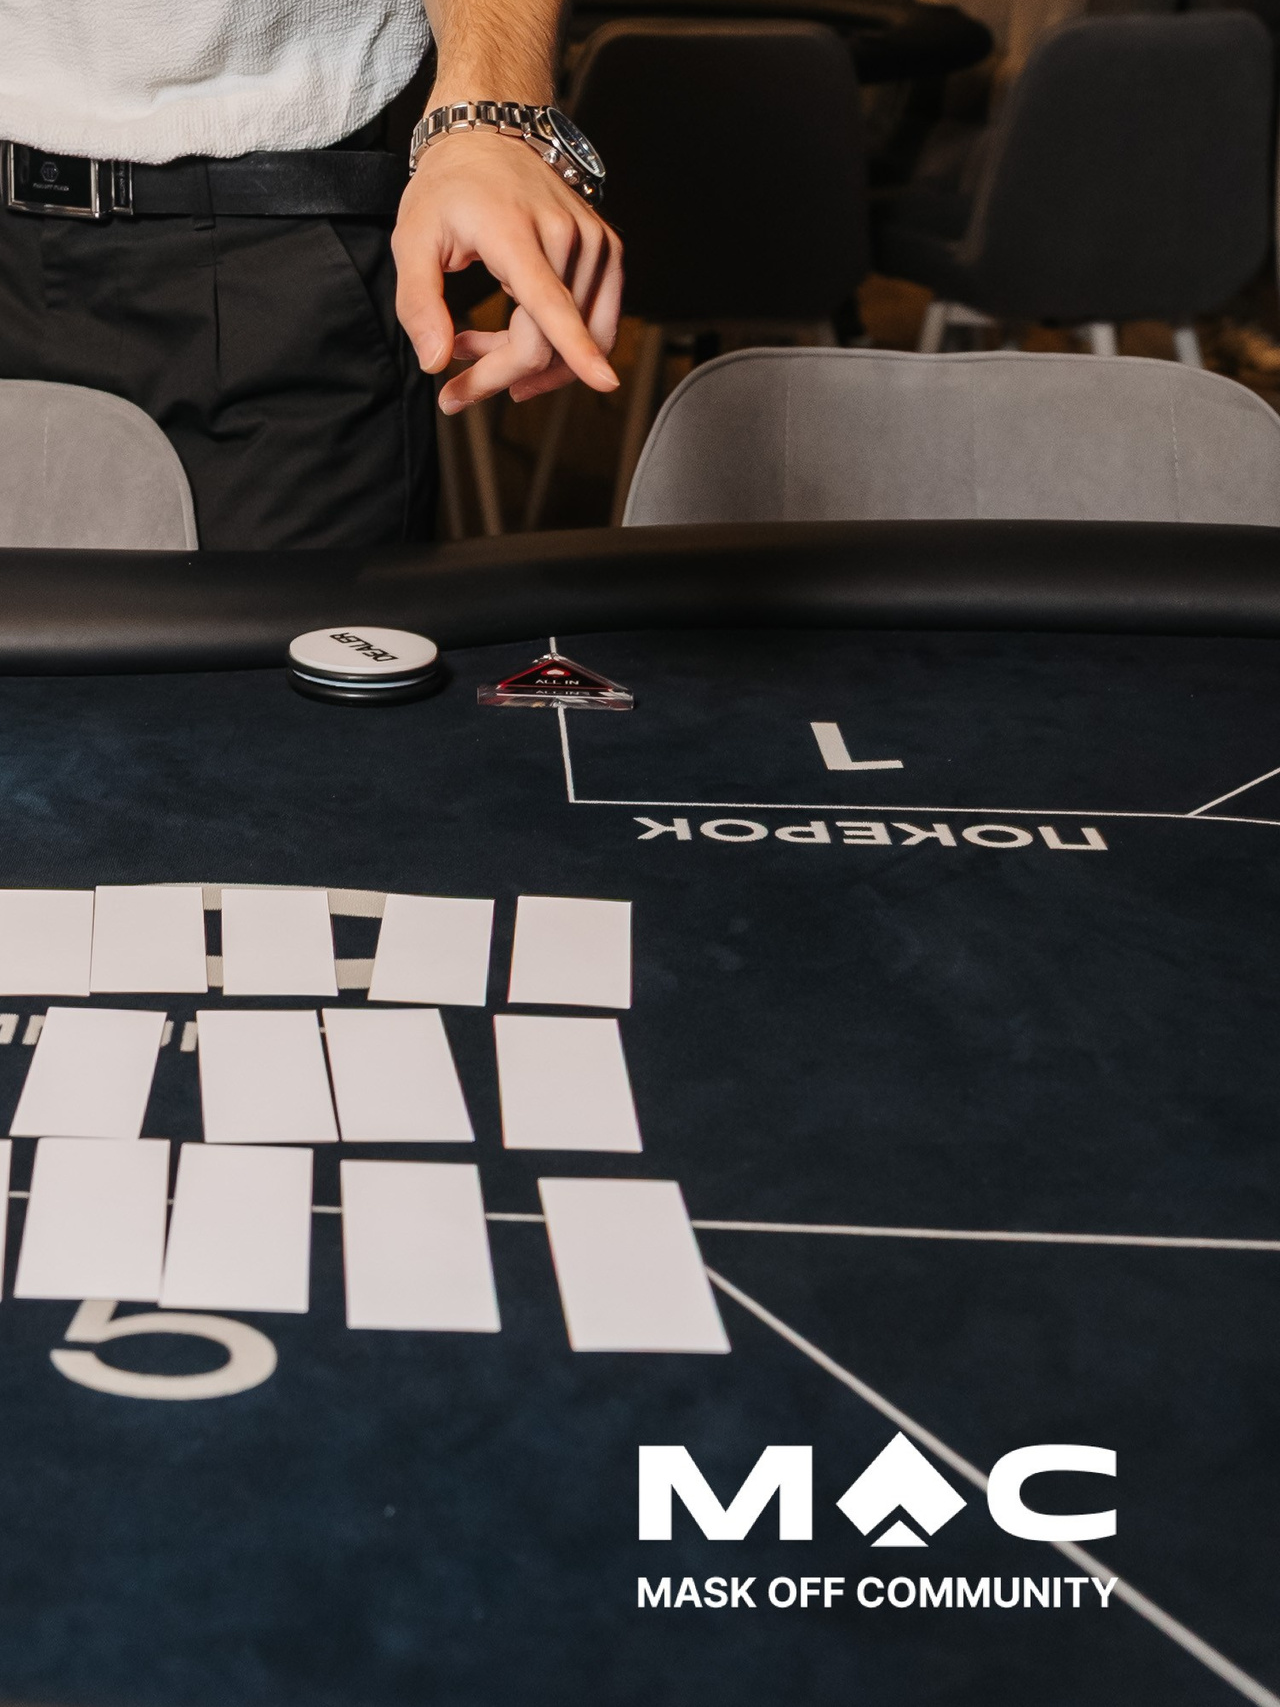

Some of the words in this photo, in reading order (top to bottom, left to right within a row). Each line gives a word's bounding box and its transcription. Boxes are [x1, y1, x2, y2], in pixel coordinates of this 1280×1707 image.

[329, 631, 399, 663] DEALER
[632, 816, 1109, 851] ПОКЕРОК
[49, 1299, 278, 1401] 5
